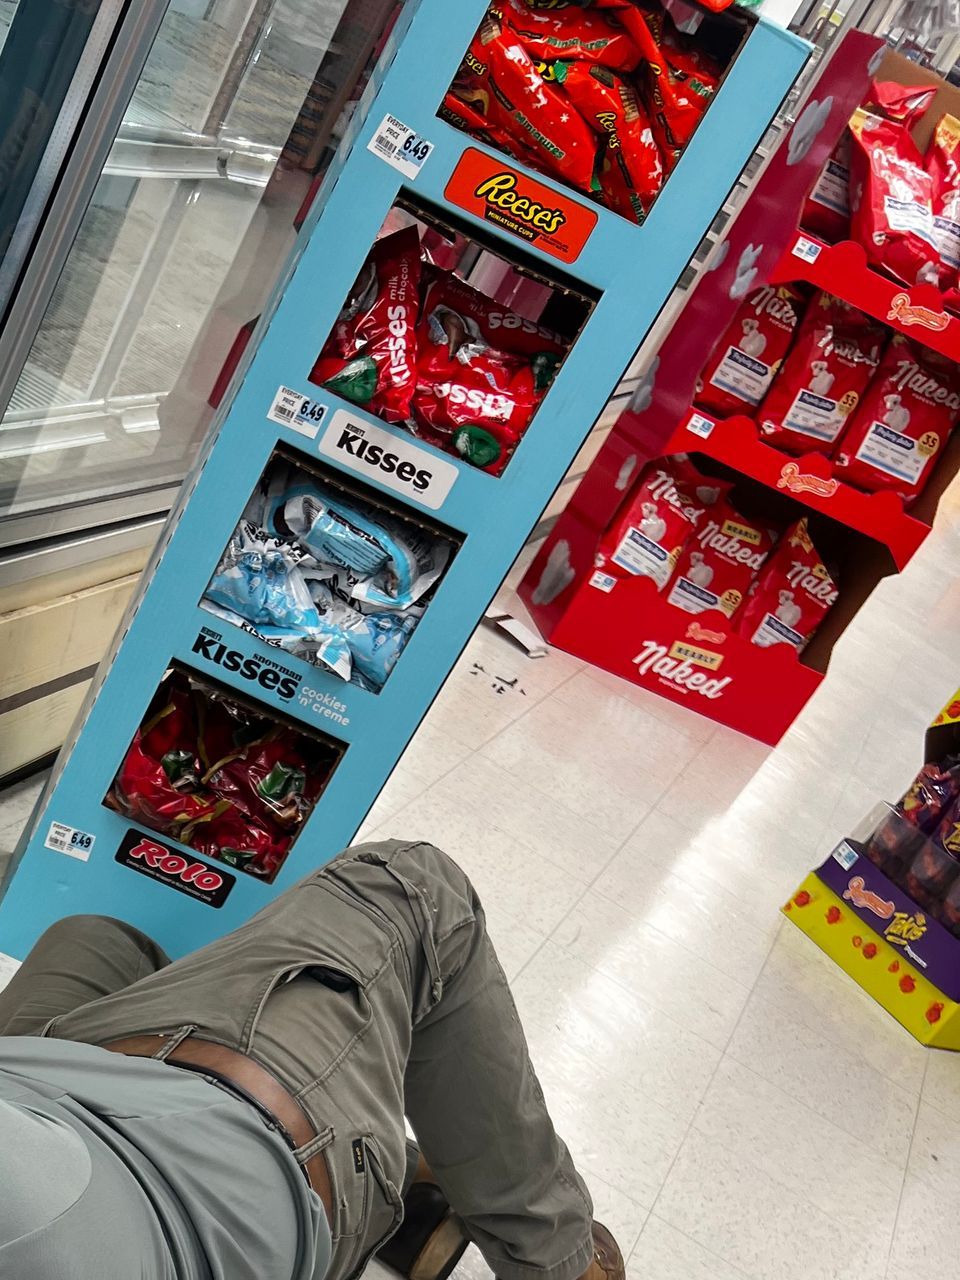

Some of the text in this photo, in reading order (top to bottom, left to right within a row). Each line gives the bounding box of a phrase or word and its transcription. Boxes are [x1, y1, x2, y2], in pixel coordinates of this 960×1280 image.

[386, 127, 400, 139] PRICE
[387, 116, 409, 133] EVERYDAY
[403, 135, 429, 160] 6.49
[475, 173, 565, 232] Reese's
[488, 210, 534, 238] MINIATURE CUPS
[390, 275, 398, 300] milk
[300, 400, 325, 421] 6.49
[922, 434, 938, 448] 35
[697, 520, 769, 570] Naked
[252, 653, 303, 682] snowman
[631, 640, 734, 699] Naked
[301, 686, 347, 713] cookies
[312, 700, 351, 727] creme
[71, 832, 92, 848] 6.49
[129, 838, 223, 891] Rolo
